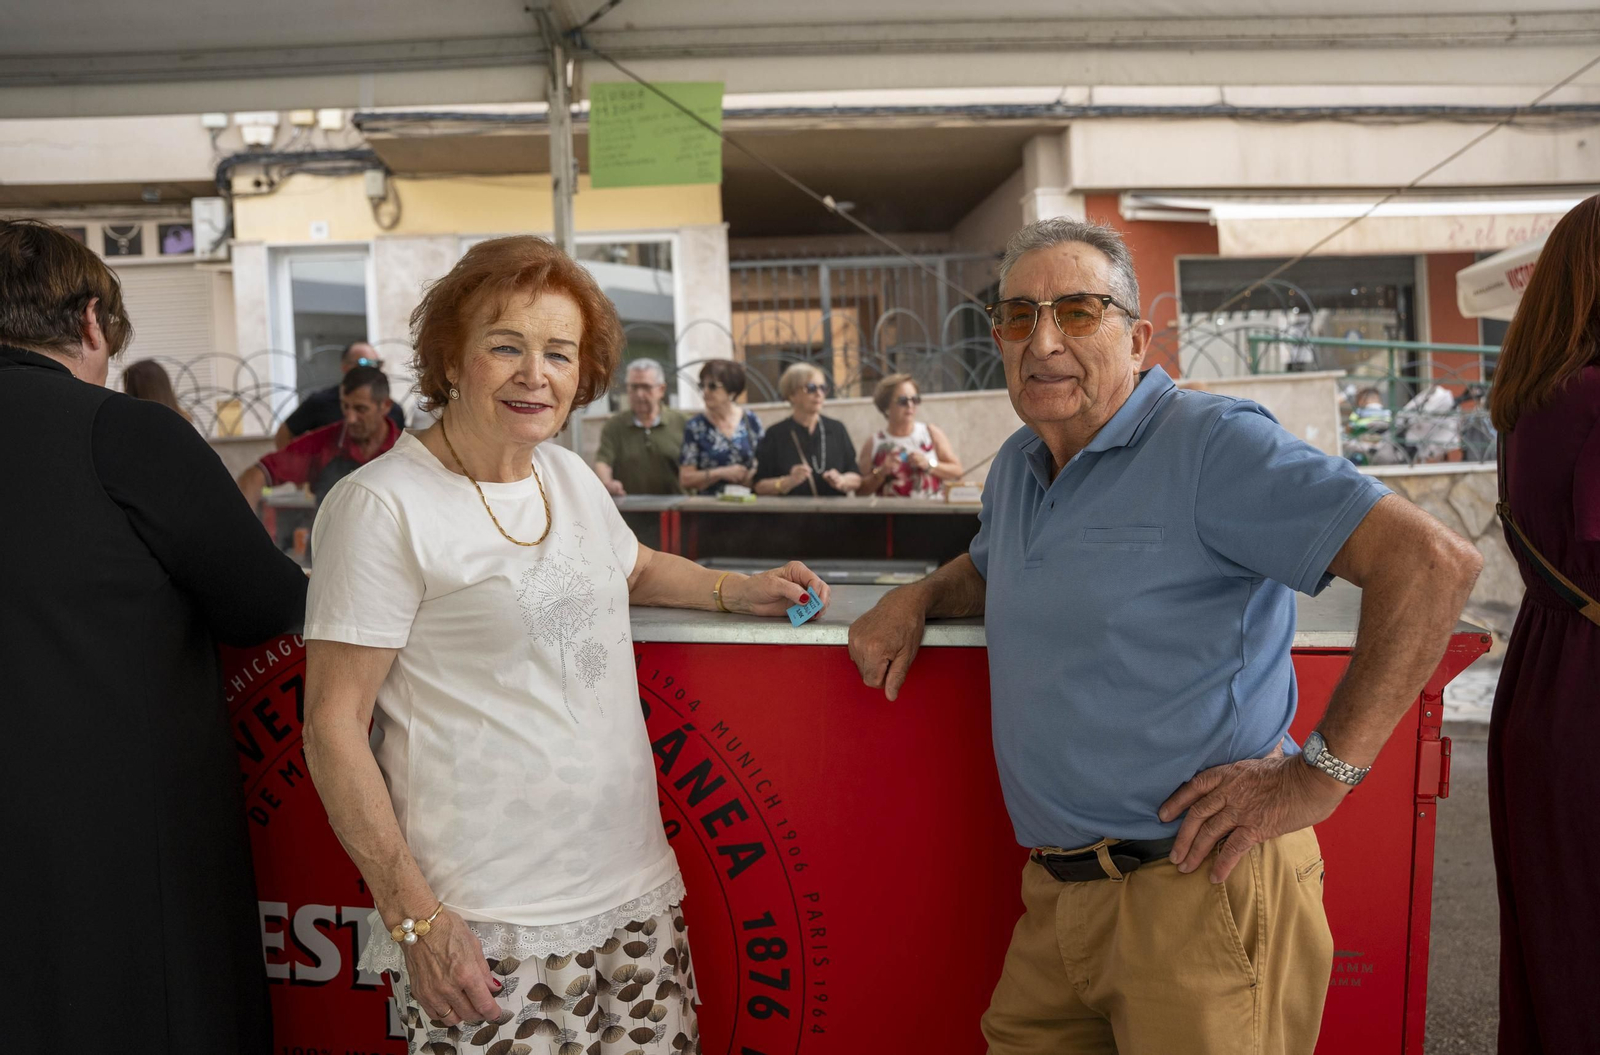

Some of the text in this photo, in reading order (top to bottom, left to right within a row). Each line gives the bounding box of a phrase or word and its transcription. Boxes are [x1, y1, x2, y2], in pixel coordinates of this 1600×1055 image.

[650, 669, 702, 713] 1904
[710, 720, 783, 811] MUNICH
[248, 787, 282, 827] DE
[777, 817, 809, 873] 1906
[803, 892, 830, 968] PARIS
[742, 911, 791, 1021] 1876
[1331, 962, 1374, 974] AMM
[810, 979, 829, 1035] 1964
